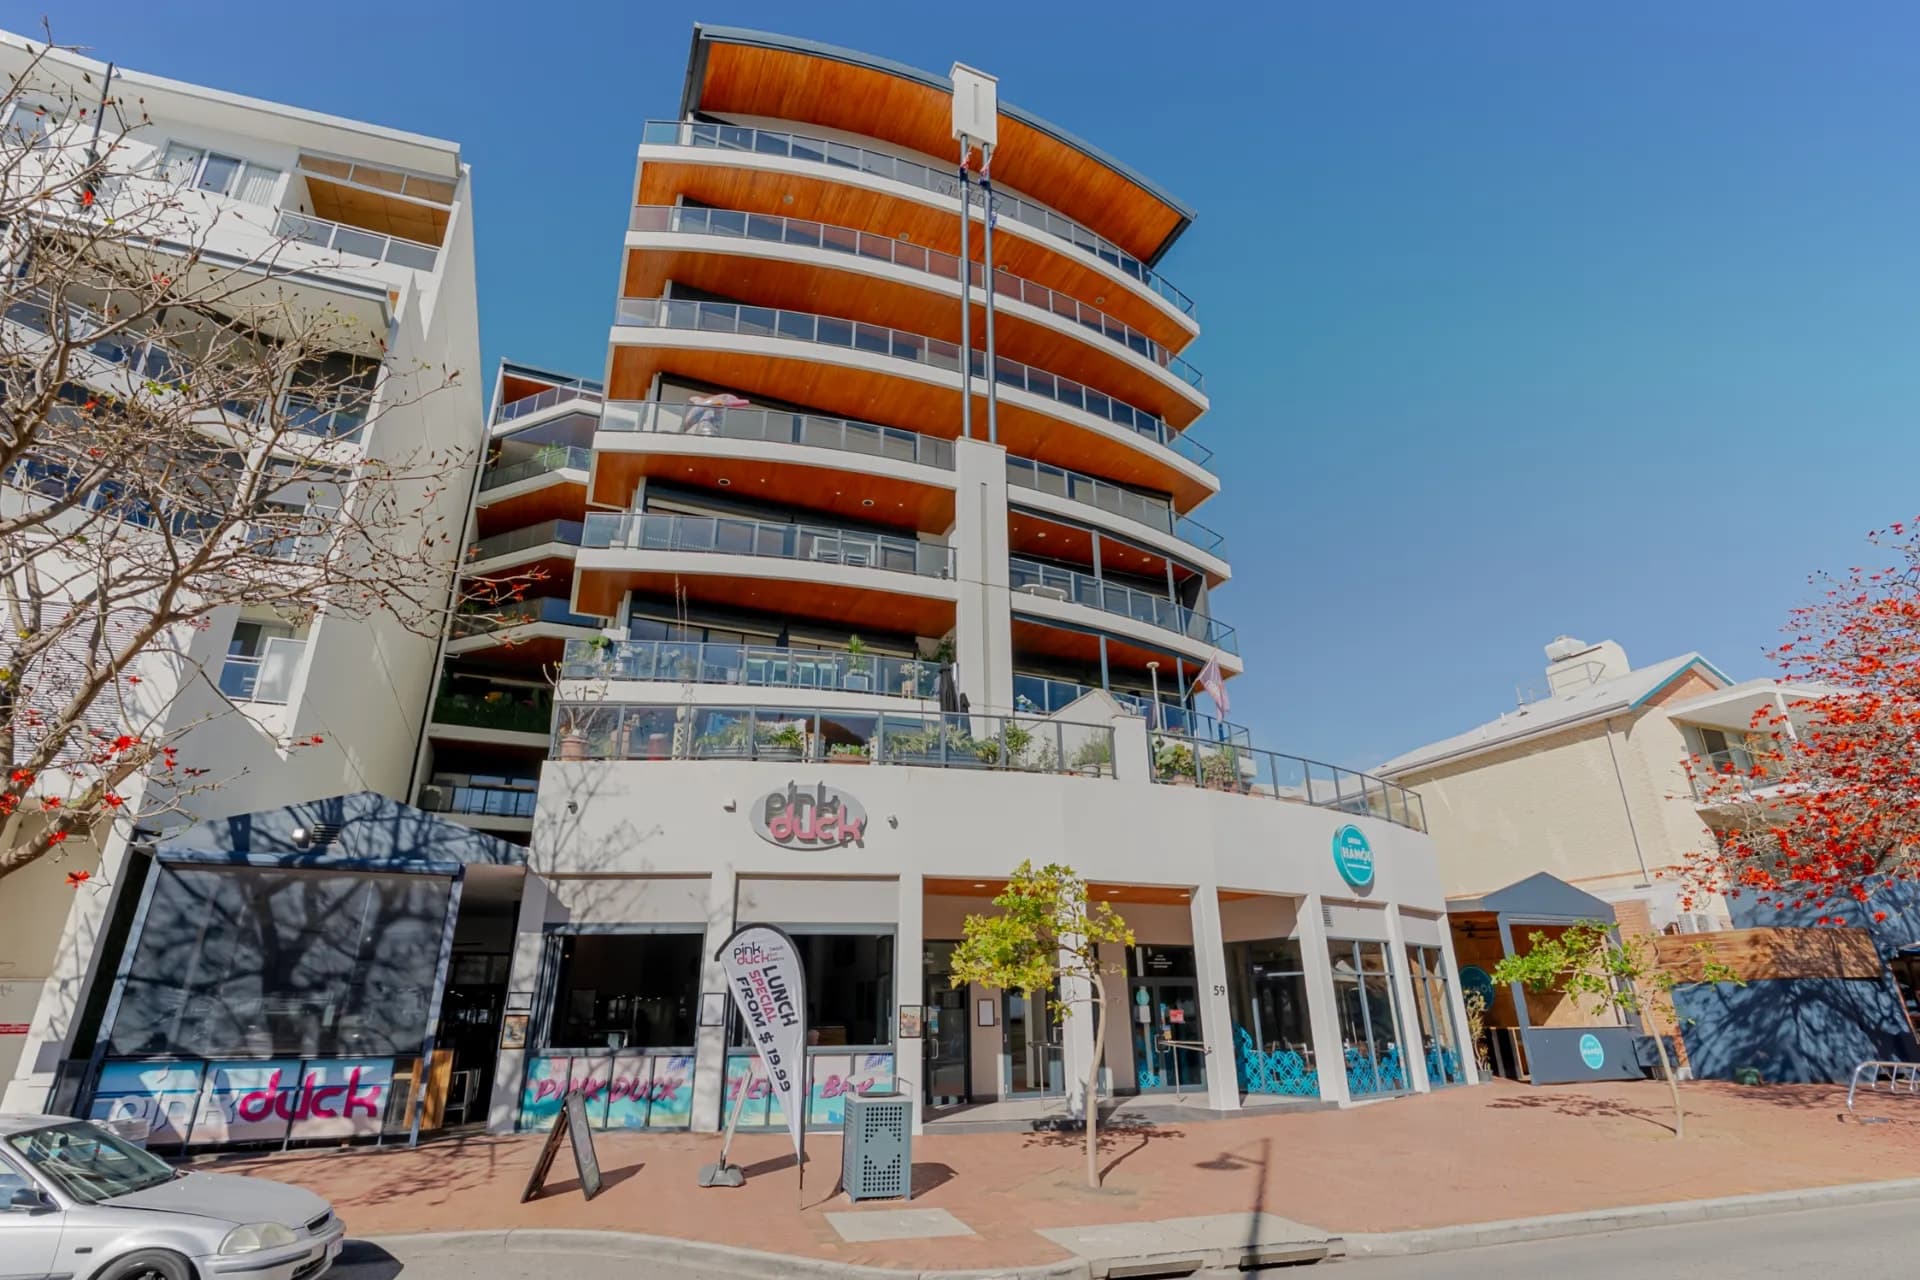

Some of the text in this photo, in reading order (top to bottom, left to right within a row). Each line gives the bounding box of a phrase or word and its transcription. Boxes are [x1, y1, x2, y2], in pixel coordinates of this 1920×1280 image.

[764, 779, 841, 826] pink
[769, 803, 864, 846] duck
[733, 941, 761, 960] pink
[736, 950, 769, 966] duck
[748, 969, 777, 1023] SPECIAL
[762, 965, 799, 1027] LUNCH
[1213, 985, 1226, 996] 59
[736, 976, 791, 1093] FROM $ 19.99
[239, 1064, 382, 1123] duck
